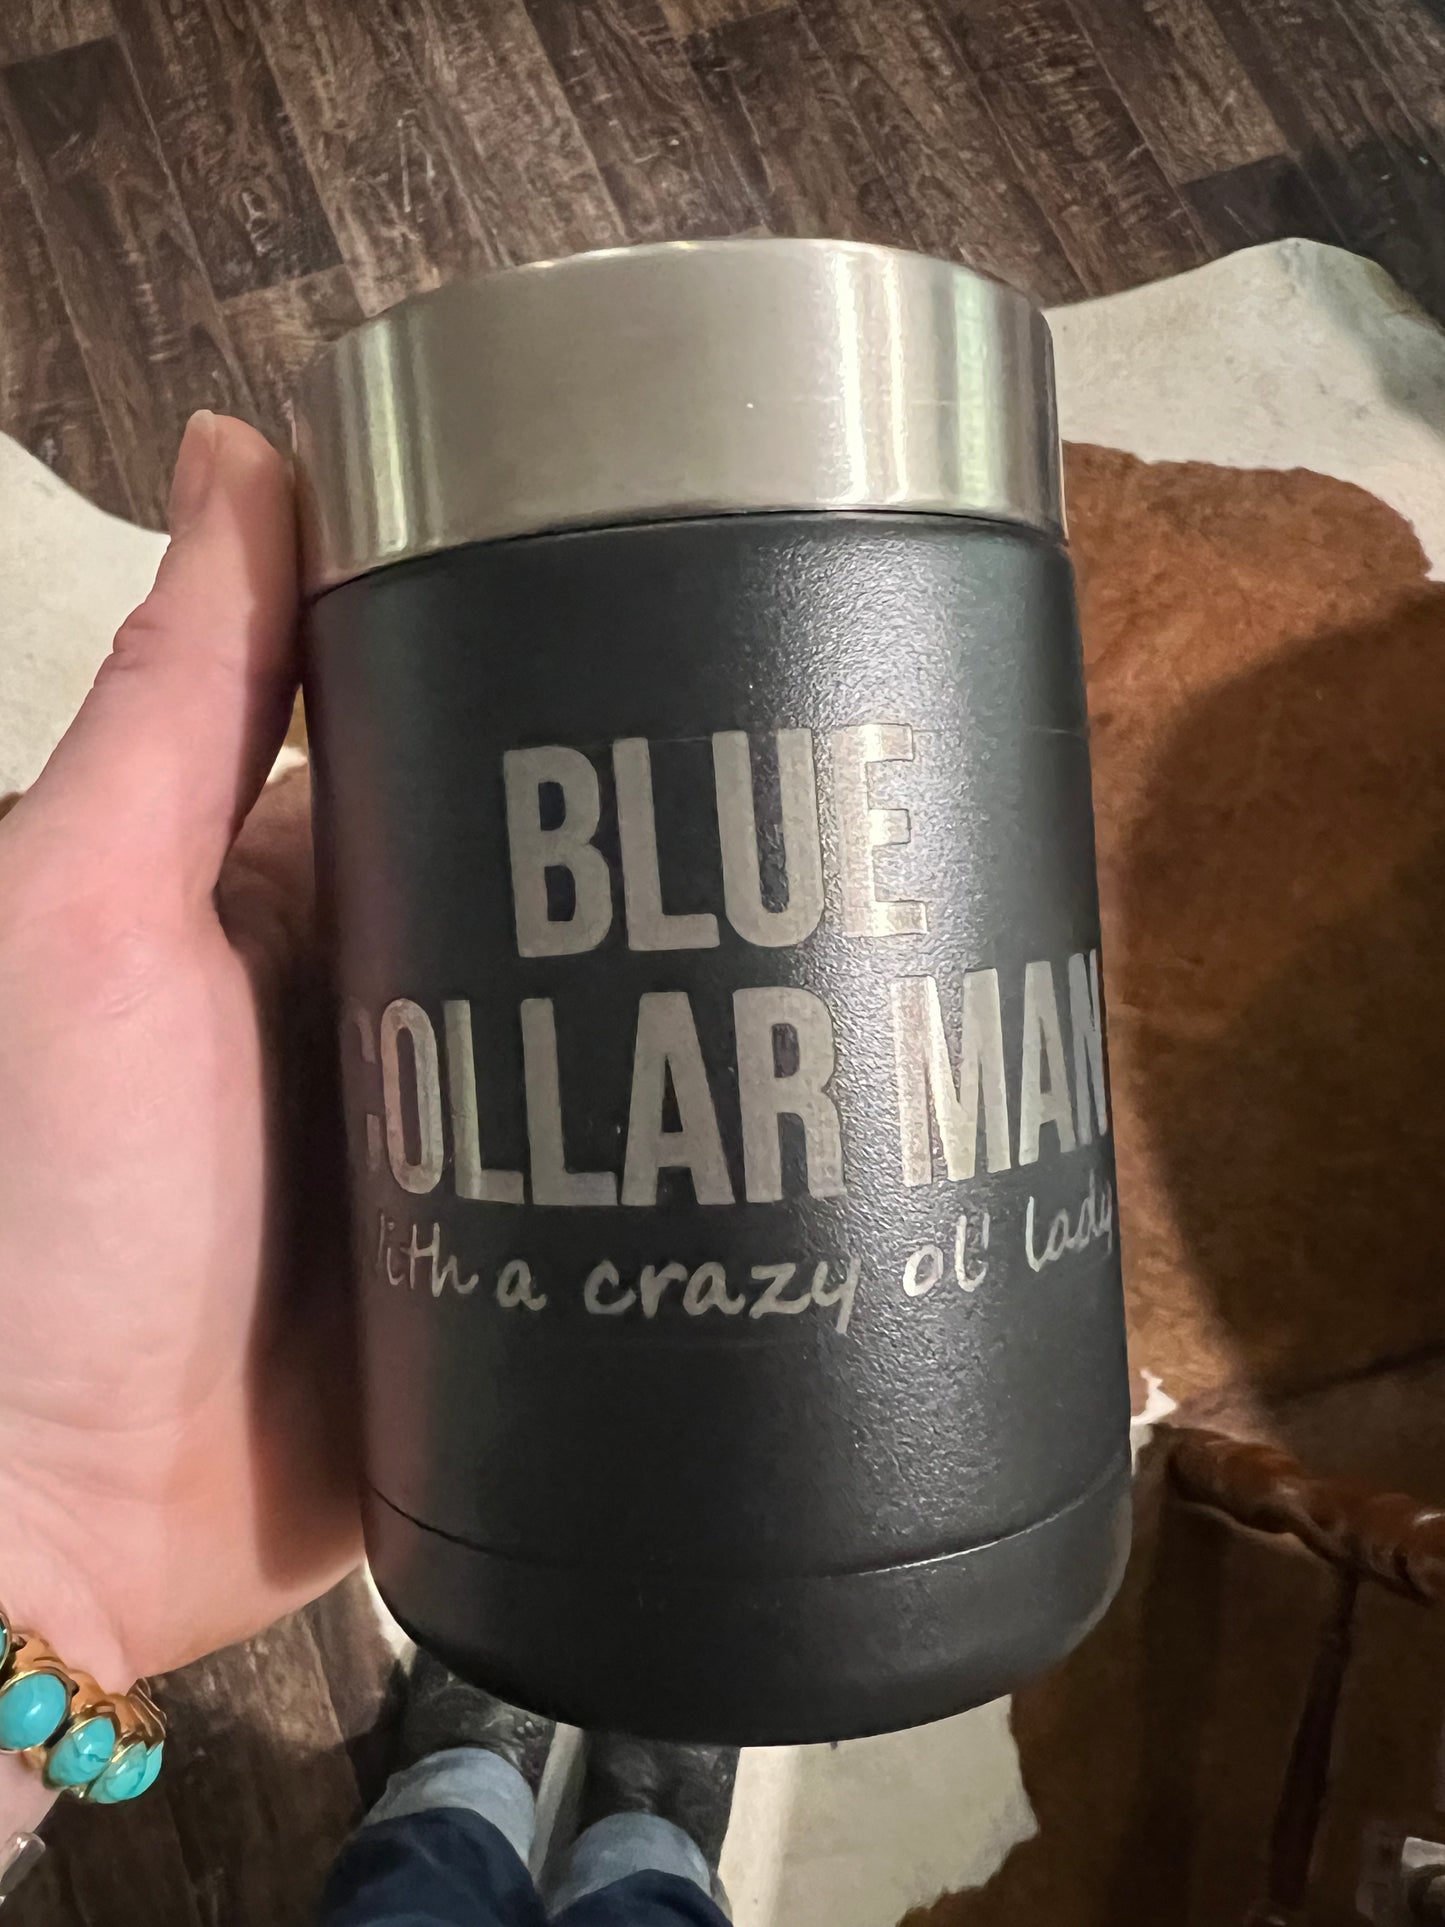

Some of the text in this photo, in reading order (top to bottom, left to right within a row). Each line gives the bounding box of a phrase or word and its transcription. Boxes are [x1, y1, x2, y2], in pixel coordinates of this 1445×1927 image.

[503, 725, 928, 958] BLUE
[889, 948, 1108, 1189] MAN
[495, 1258, 547, 1312] a
[583, 1257, 862, 1335] crazy
[1024, 1168, 1113, 1272] lady
